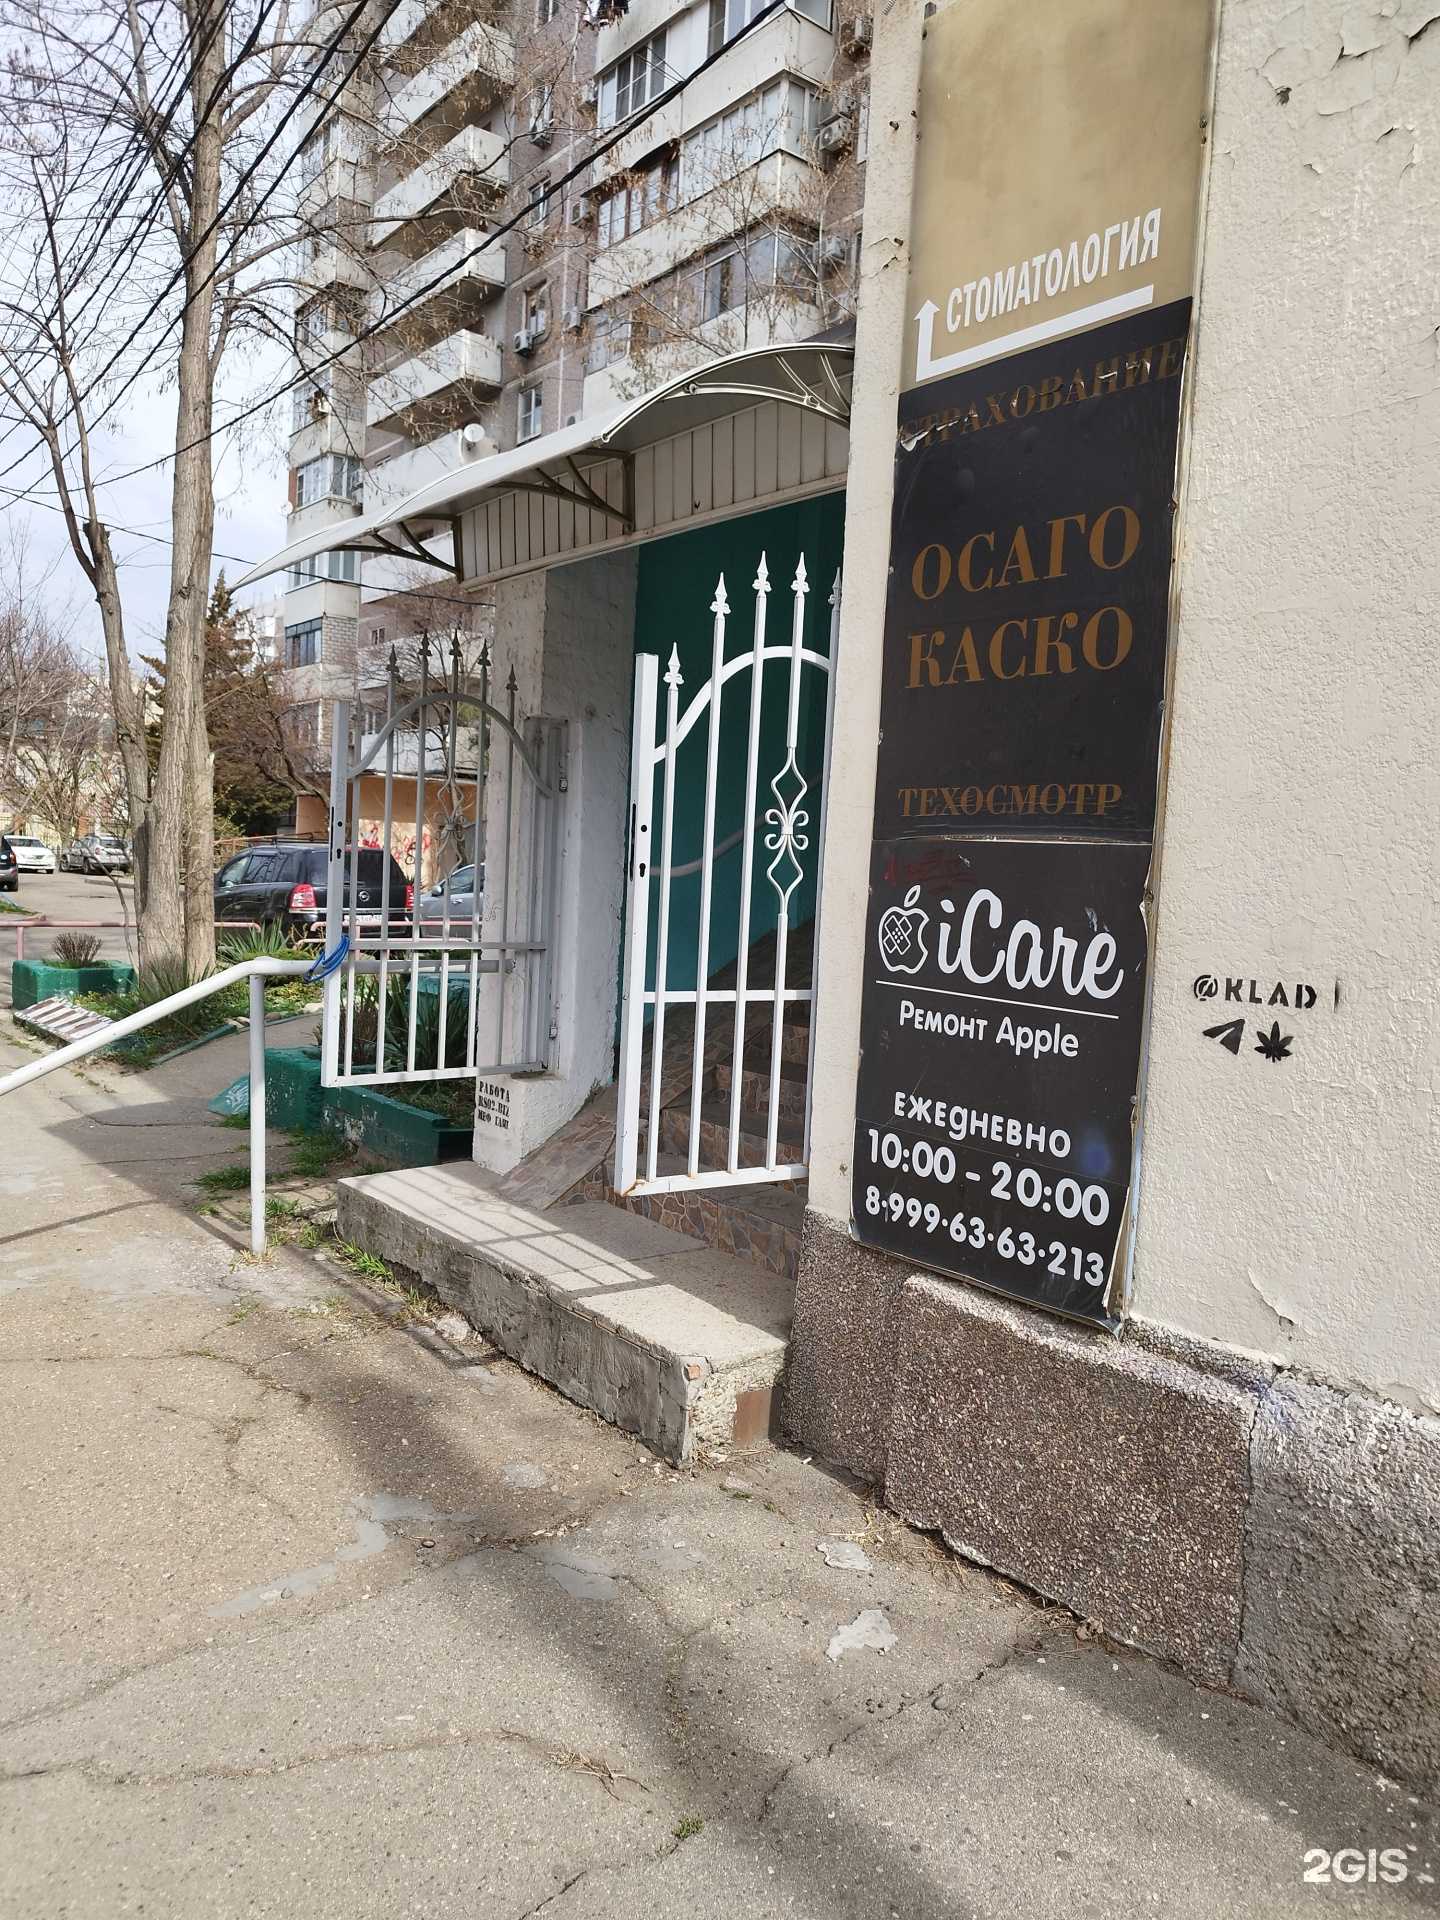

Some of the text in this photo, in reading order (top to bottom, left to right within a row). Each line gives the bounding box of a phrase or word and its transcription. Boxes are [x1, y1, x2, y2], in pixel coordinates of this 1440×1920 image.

[946, 207, 1161, 333] СТОМАТОЛОГИЯ
[911, 505, 1141, 601] ОСАГО
[905, 606, 1134, 689] КАСКО
[898, 783, 1122, 817] ТЕХОСМОТР
[937, 888, 1124, 1000] iCare
[1193, 974, 1317, 1009] @KLAD
[995, 1016, 1079, 1059] Apple
[479, 1080, 510, 1103] РАБОТА
[868, 1128, 956, 1184] 10:00
[990, 1161, 1110, 1226] 20:00
